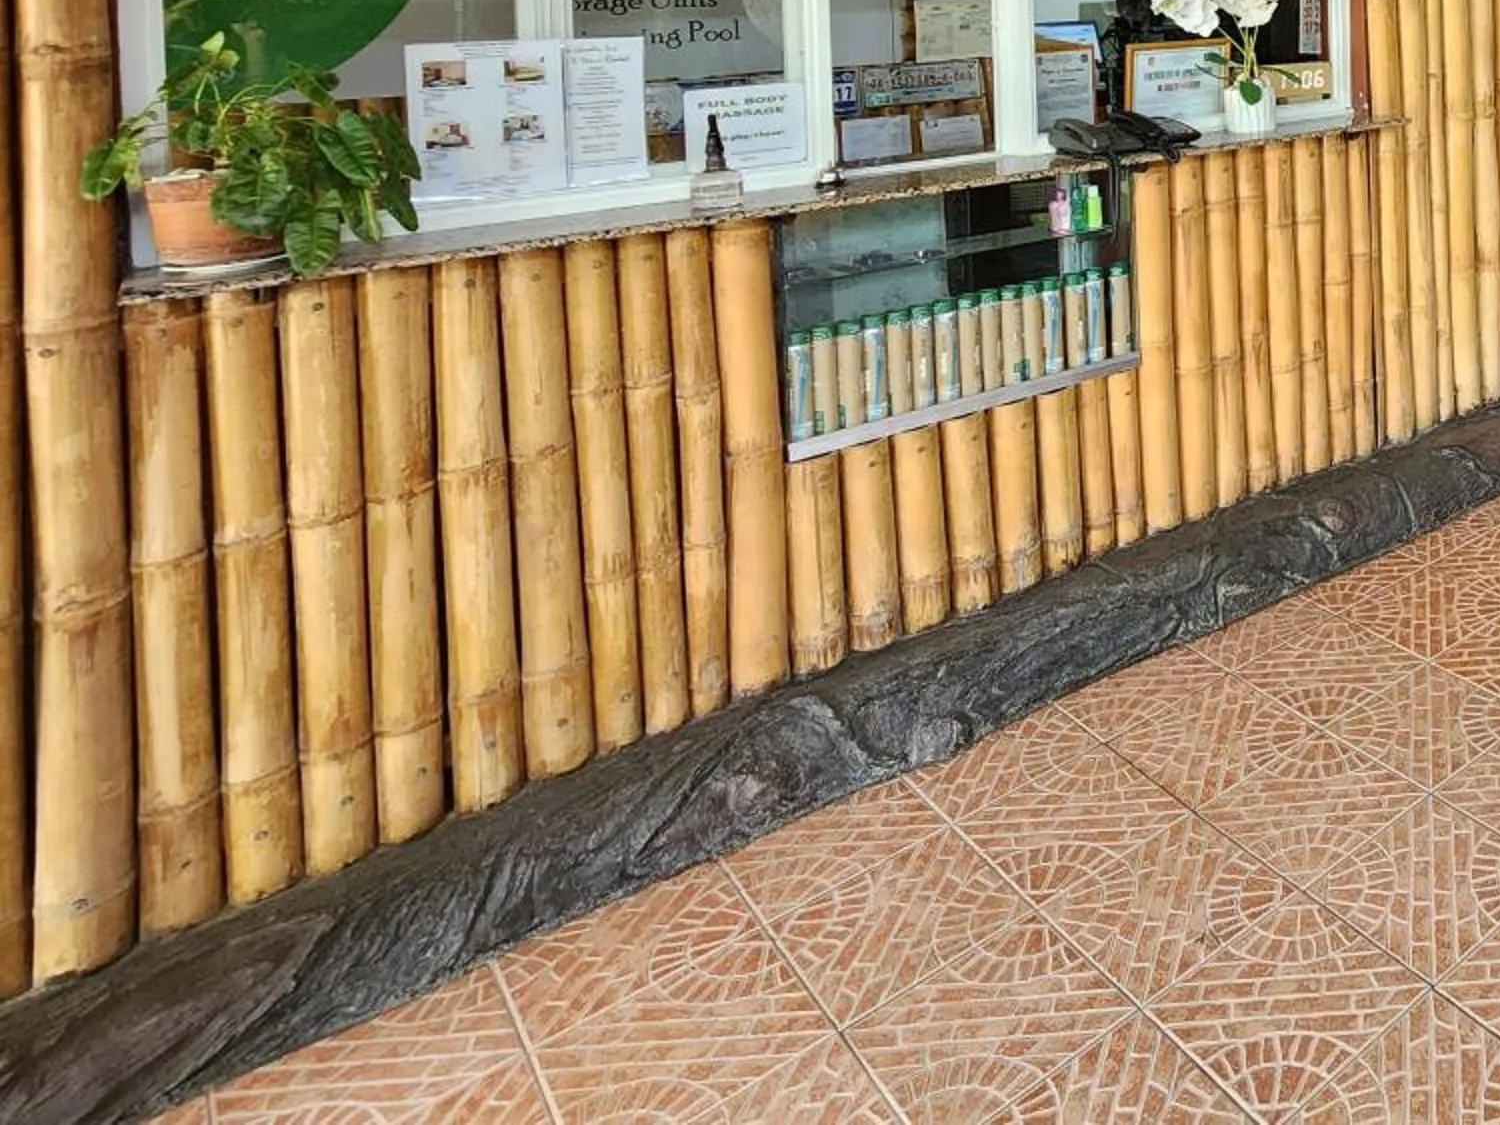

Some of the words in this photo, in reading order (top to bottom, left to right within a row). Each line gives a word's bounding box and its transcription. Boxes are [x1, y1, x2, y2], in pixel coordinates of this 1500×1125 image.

[688, 19, 742, 42] Pool
[698, 98, 742, 110] FULL
[744, 94, 788, 105] BODY
